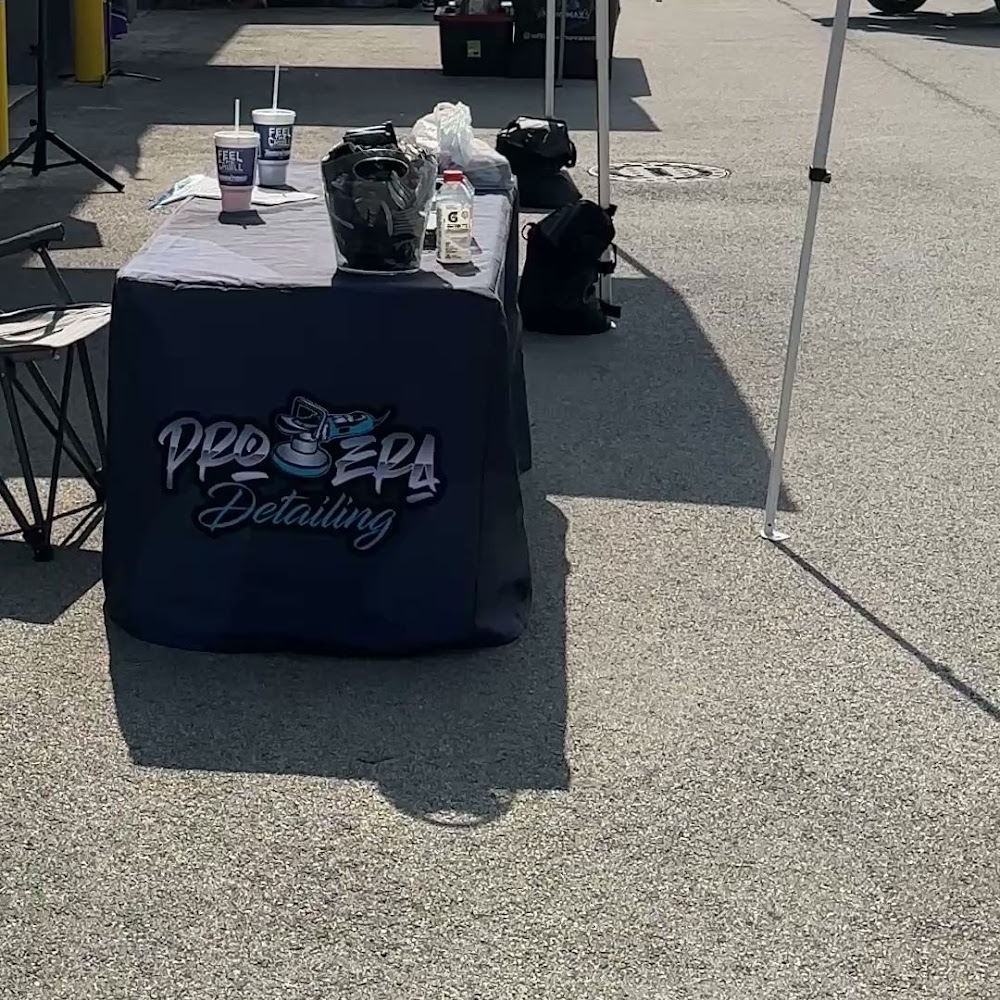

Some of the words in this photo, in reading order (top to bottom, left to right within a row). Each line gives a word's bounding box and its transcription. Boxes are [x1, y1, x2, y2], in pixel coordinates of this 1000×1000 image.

[447, 211, 459, 223] G
[158, 417, 270, 489] PRO
[331, 432, 440, 503] ERA
[198, 482, 396, 550] Detailing
